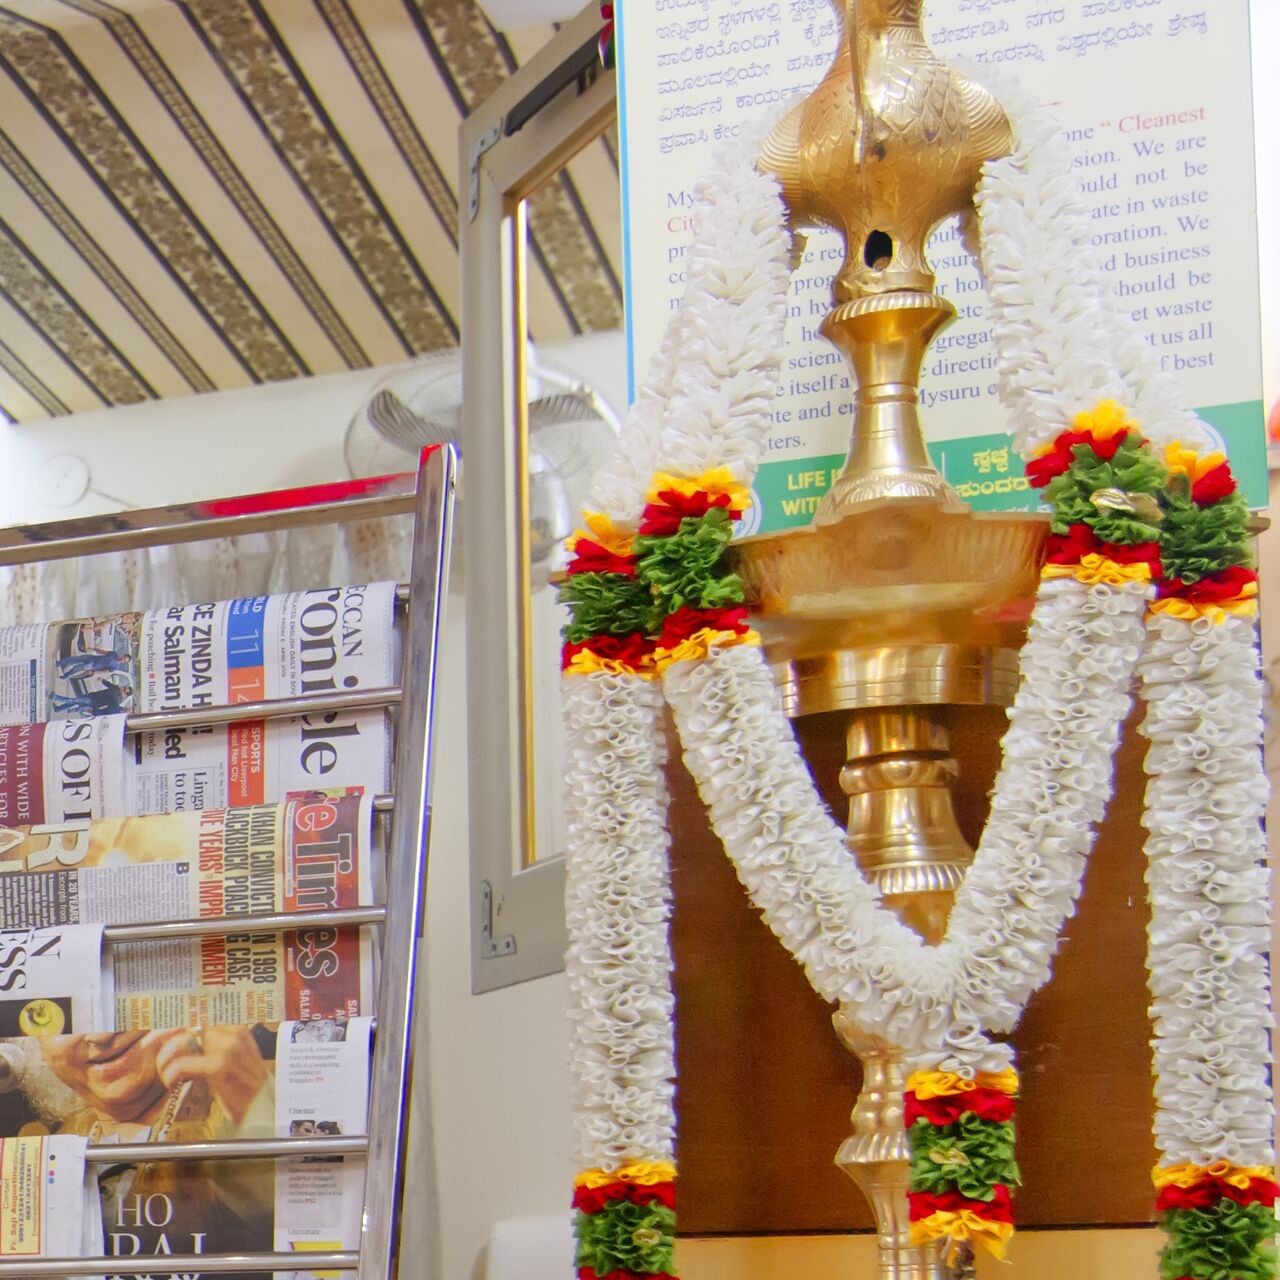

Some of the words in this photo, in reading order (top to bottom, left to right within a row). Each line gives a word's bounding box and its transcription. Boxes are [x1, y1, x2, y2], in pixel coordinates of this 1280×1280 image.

[1118, 107, 1206, 134] Cleanest
[1133, 138, 1165, 157] We
[1176, 134, 1207, 152] are
[1135, 167, 1167, 185] not
[1183, 160, 1209, 178] be
[1126, 196, 1145, 215] in
[1152, 187, 1209, 209] waste
[1177, 215, 1210, 232] We
[1124, 243, 1211, 270] business
[1188, 269, 1213, 287] be
[1155, 295, 1214, 318] waste
[1161, 327, 1183, 345] us
[1189, 320, 1213, 341] all
[1173, 351, 1215, 371] best
[790, 374, 837, 397] itself
[797, 400, 831, 421] and
[788, 470, 825, 491] LIFE
[147, 634, 157, 672] poaching
[230, 629, 259, 654] 11
[164, 626, 185, 701] Salman
[191, 625, 212, 688] ZINDA
[148, 682, 156, 697] Bail
[17, 736, 28, 777] WITH
[147, 732, 158, 756] today
[231, 748, 239, 764] Man
[250, 728, 260, 772] SPORTS
[61, 749, 92, 801] OF
[174, 773, 188, 789] to
[230, 766, 239, 782] City
[240, 760, 248, 797] Liverpool
[17, 783, 29, 819] WIDE
[250, 811, 275, 848] KHAN
[58, 872, 67, 902] Excerpts
[69, 882, 78, 892] 20
[59, 905, 67, 921] from
[252, 949, 277, 984] 1998
